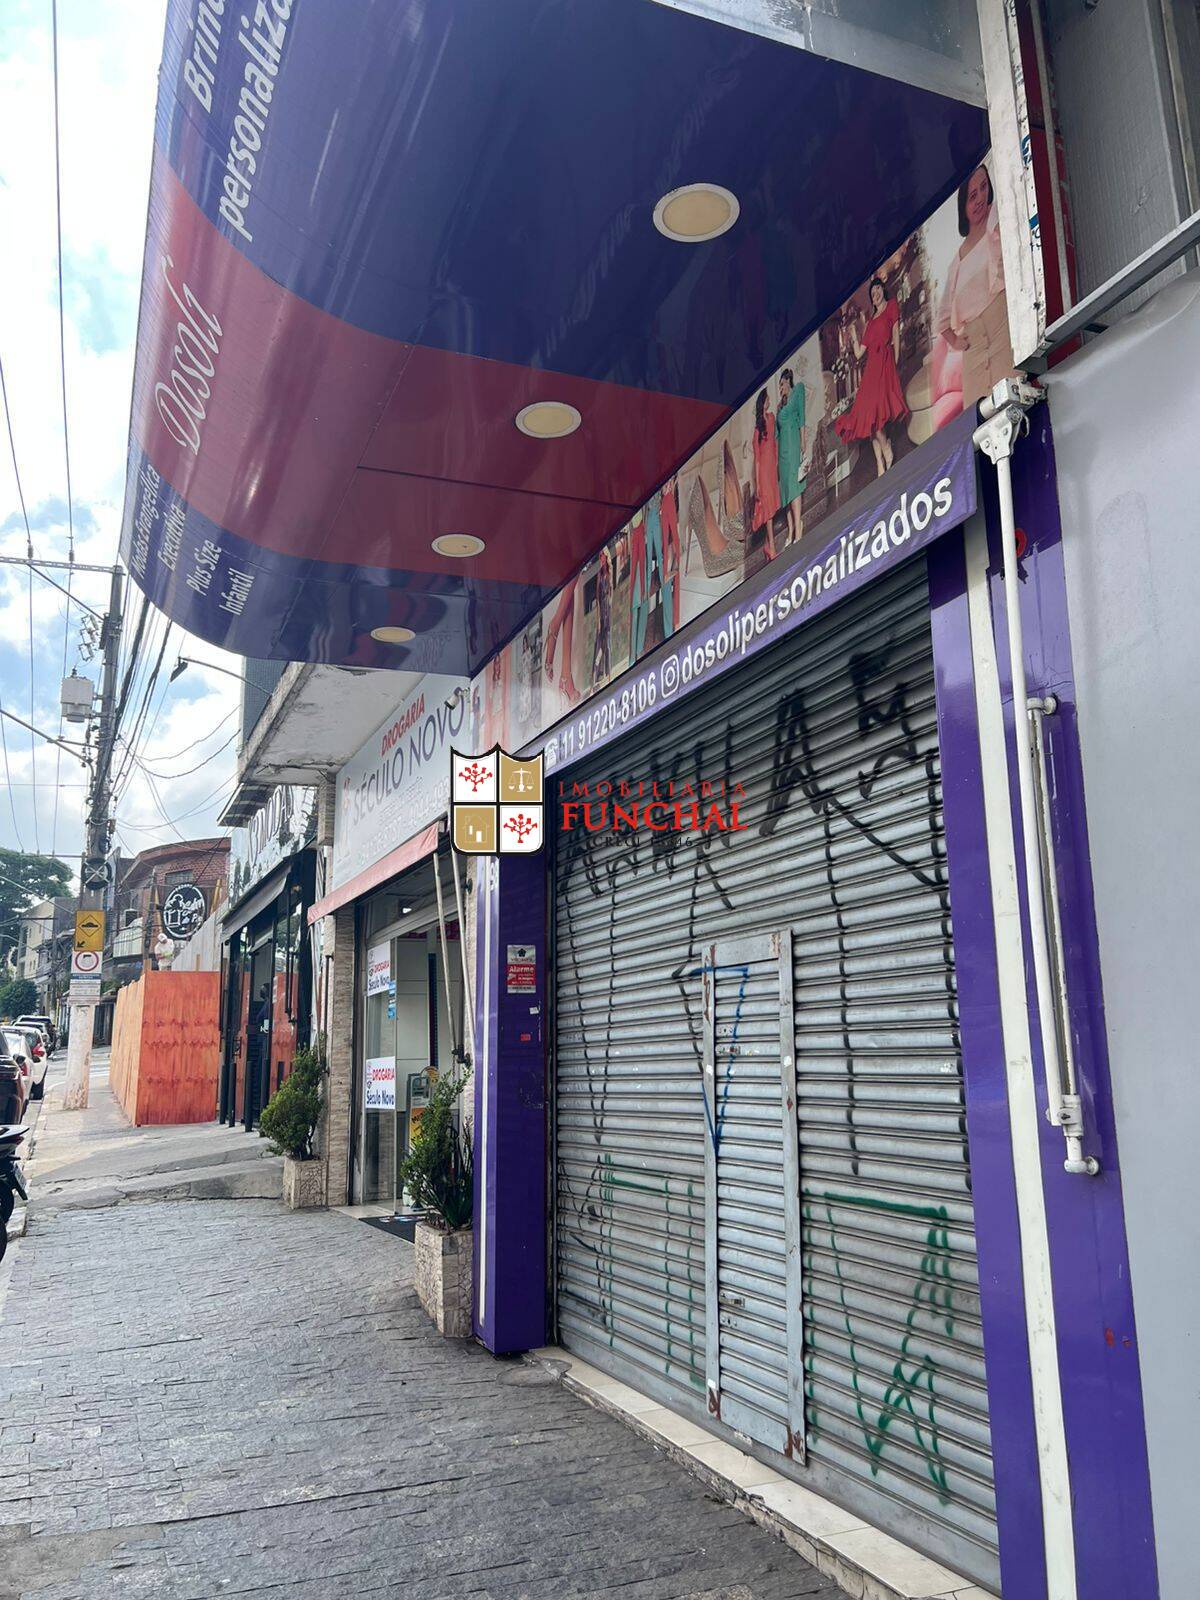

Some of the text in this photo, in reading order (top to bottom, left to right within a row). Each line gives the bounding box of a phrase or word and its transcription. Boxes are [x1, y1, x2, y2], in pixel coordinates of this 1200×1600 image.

[158, 503, 186, 572] Executiva
[186, 540, 221, 596] Plus Size
[219, 568, 255, 615] Infantil
[563, 477, 953, 759] 11 91220-8106 dosolipersonalizados
[354, 747, 404, 826] SÉCULO
[409, 686, 465, 776] NOVO
[381, 693, 425, 756] DROGARIA
